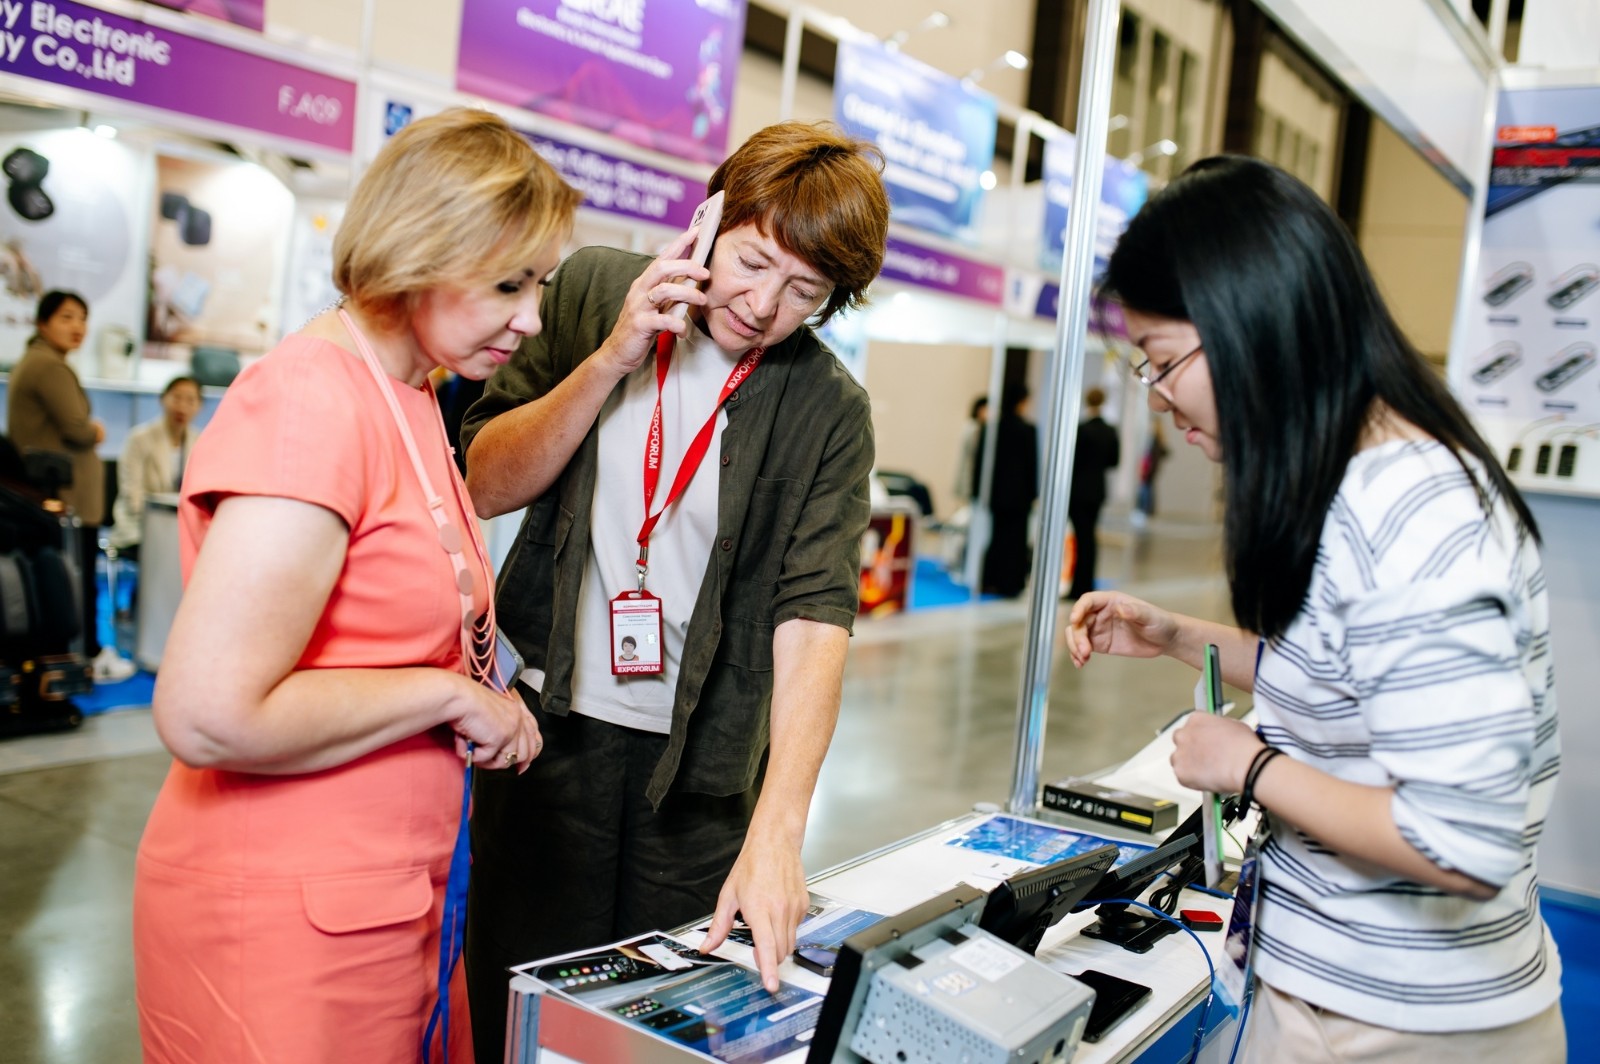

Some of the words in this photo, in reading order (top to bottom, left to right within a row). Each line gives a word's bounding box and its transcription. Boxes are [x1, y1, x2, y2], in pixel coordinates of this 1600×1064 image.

[31, 0, 171, 66] Electronic
[648, 405, 660, 469] EXPOFORUM
[617, 665, 660, 673] EXPOFORUM
